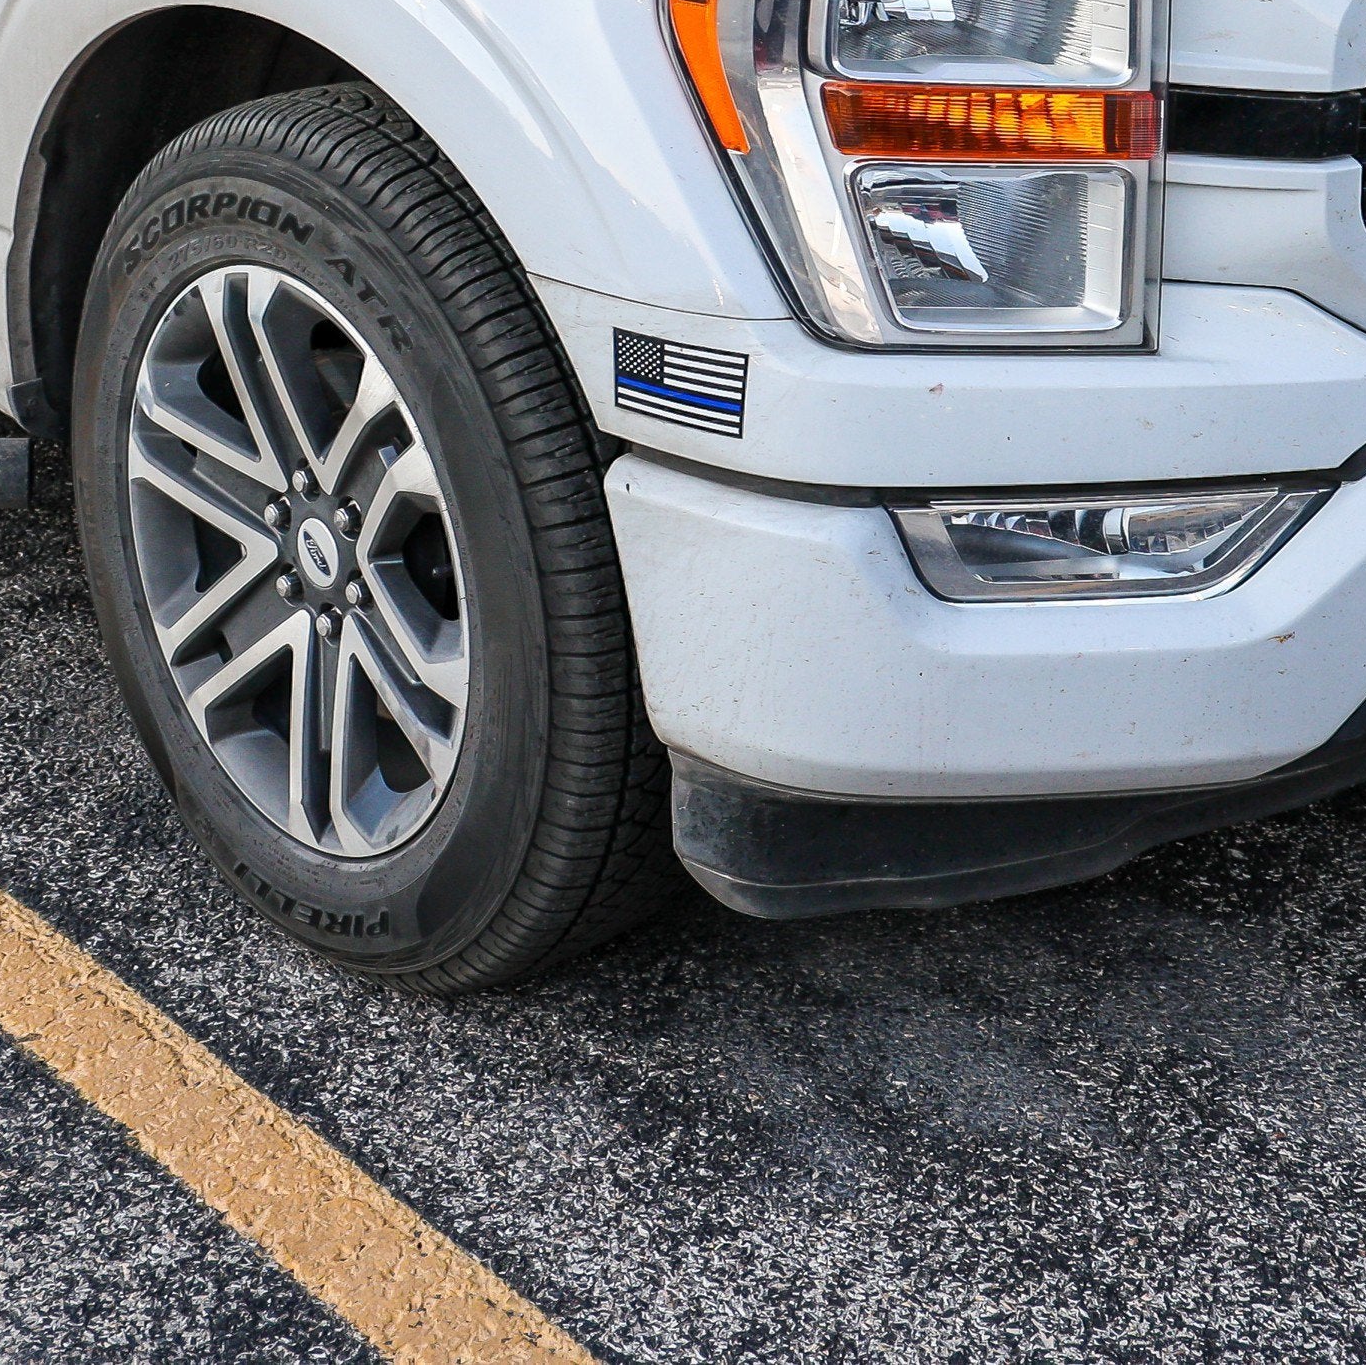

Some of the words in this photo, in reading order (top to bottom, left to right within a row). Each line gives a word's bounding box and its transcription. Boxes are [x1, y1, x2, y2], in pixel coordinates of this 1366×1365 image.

[123, 191, 317, 276] SCORPION
[324, 258, 414, 352] ATR
[304, 538, 328, 571] Ford
[233, 861, 390, 939] PIRELLI
